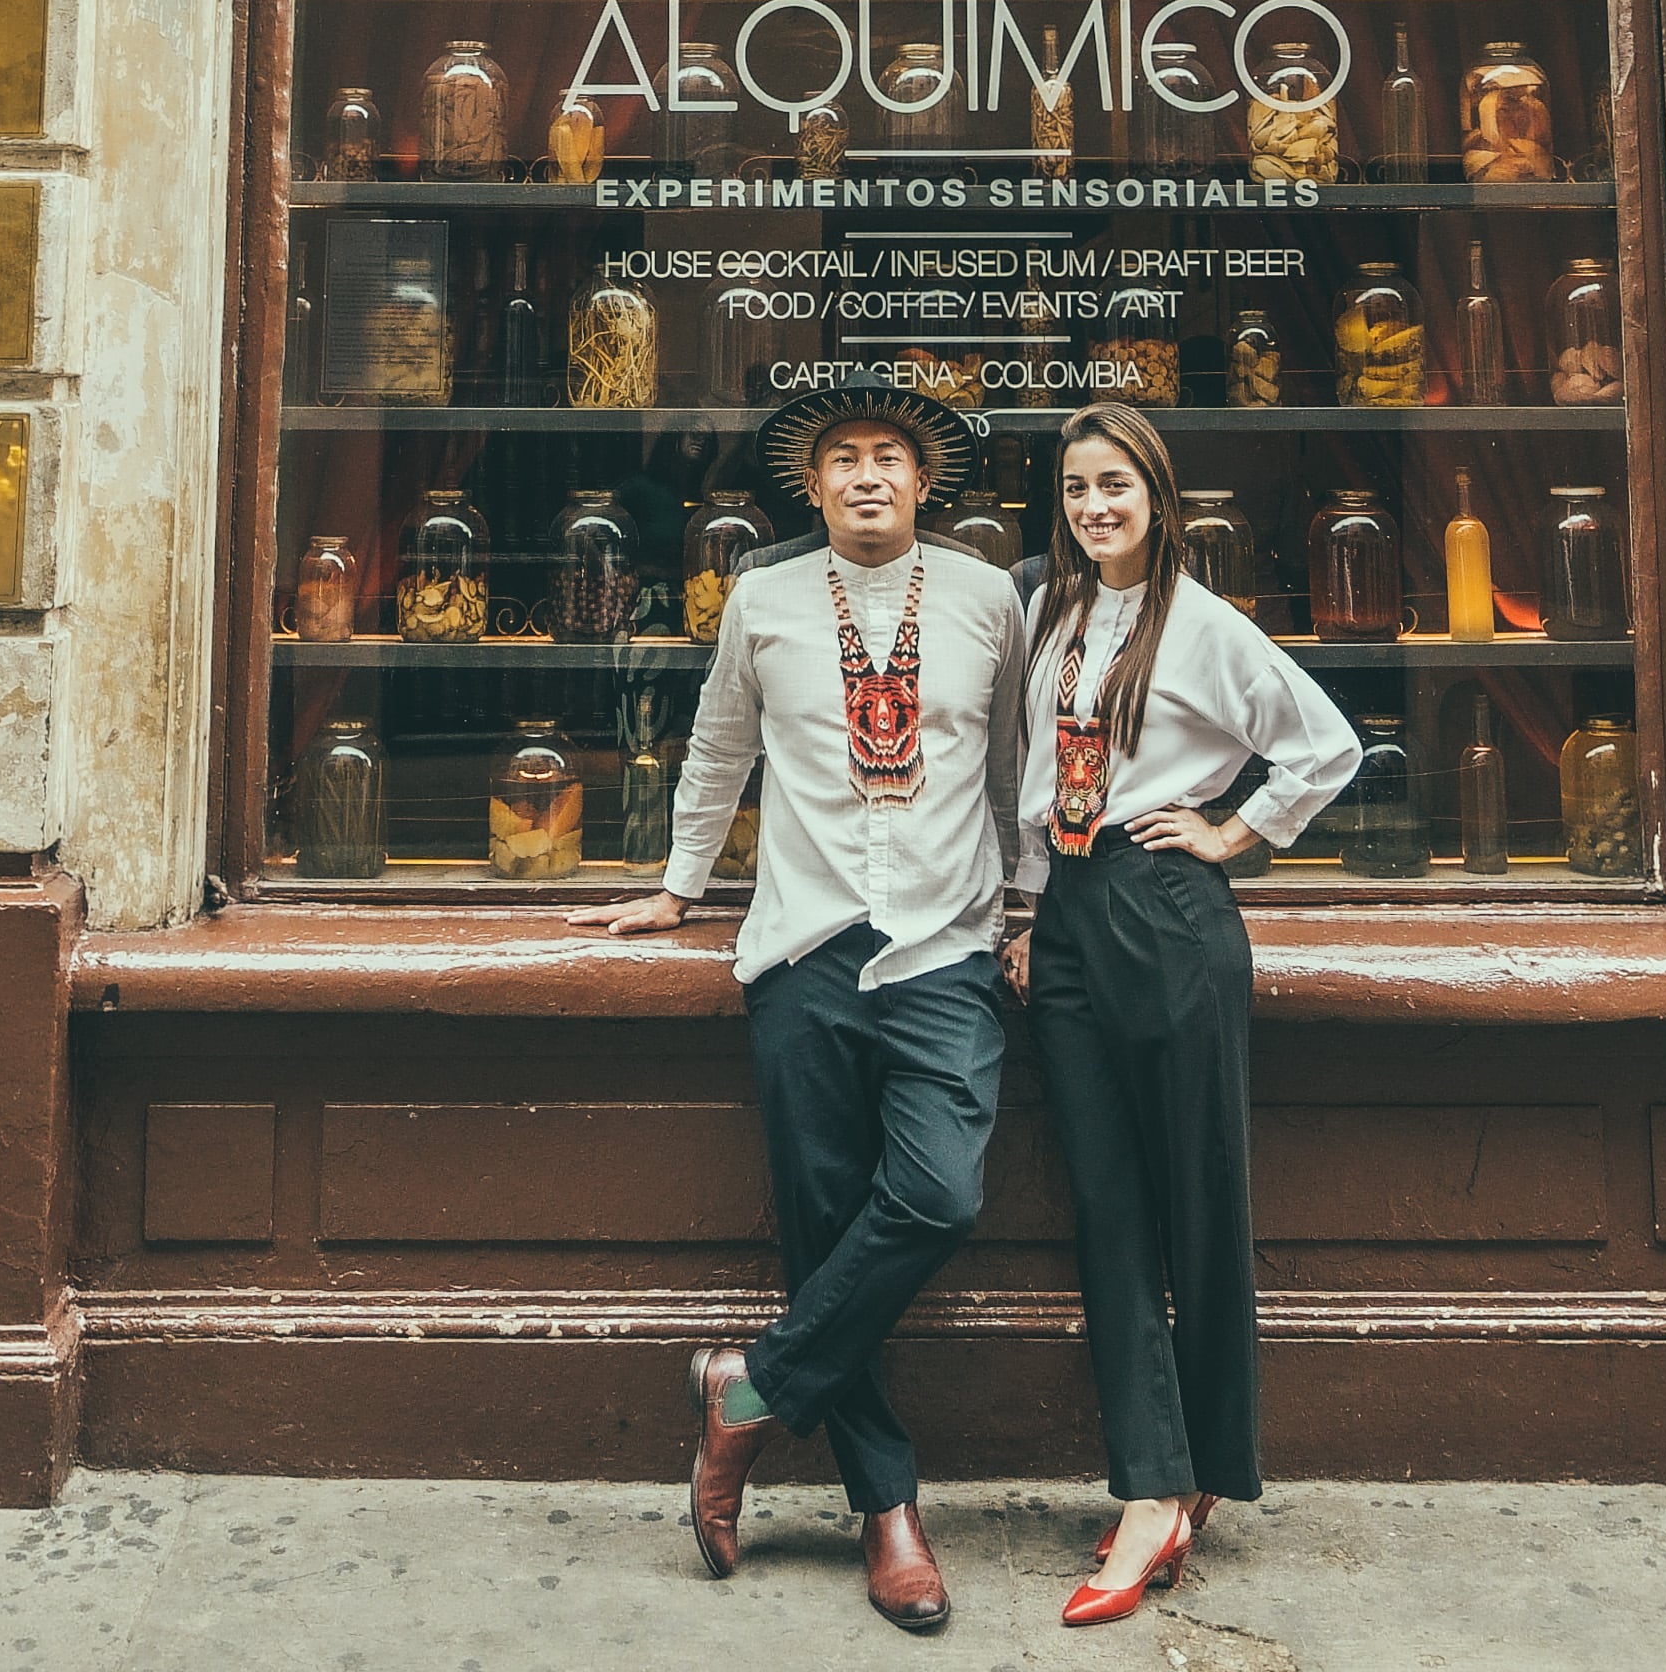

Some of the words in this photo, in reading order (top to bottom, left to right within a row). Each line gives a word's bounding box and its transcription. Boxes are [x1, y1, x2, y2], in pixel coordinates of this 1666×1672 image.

[596, 178, 967, 208] EXPERIMENTOS
[989, 178, 1320, 208] SENSORIALES
[604, 250, 712, 279] HOUSE
[717, 250, 868, 278] COCKTAIL
[890, 249, 1019, 278] INFUSED
[1025, 249, 1095, 277] RUM
[1120, 249, 1219, 277] DRAFT
[1225, 249, 1305, 277] BEER
[727, 291, 816, 320] FOOD
[839, 291, 958, 320] COFFEE
[982, 290, 1100, 319] EVENTS
[1120, 290, 1184, 319] ART
[980, 360, 1145, 390] COLOMBIA
